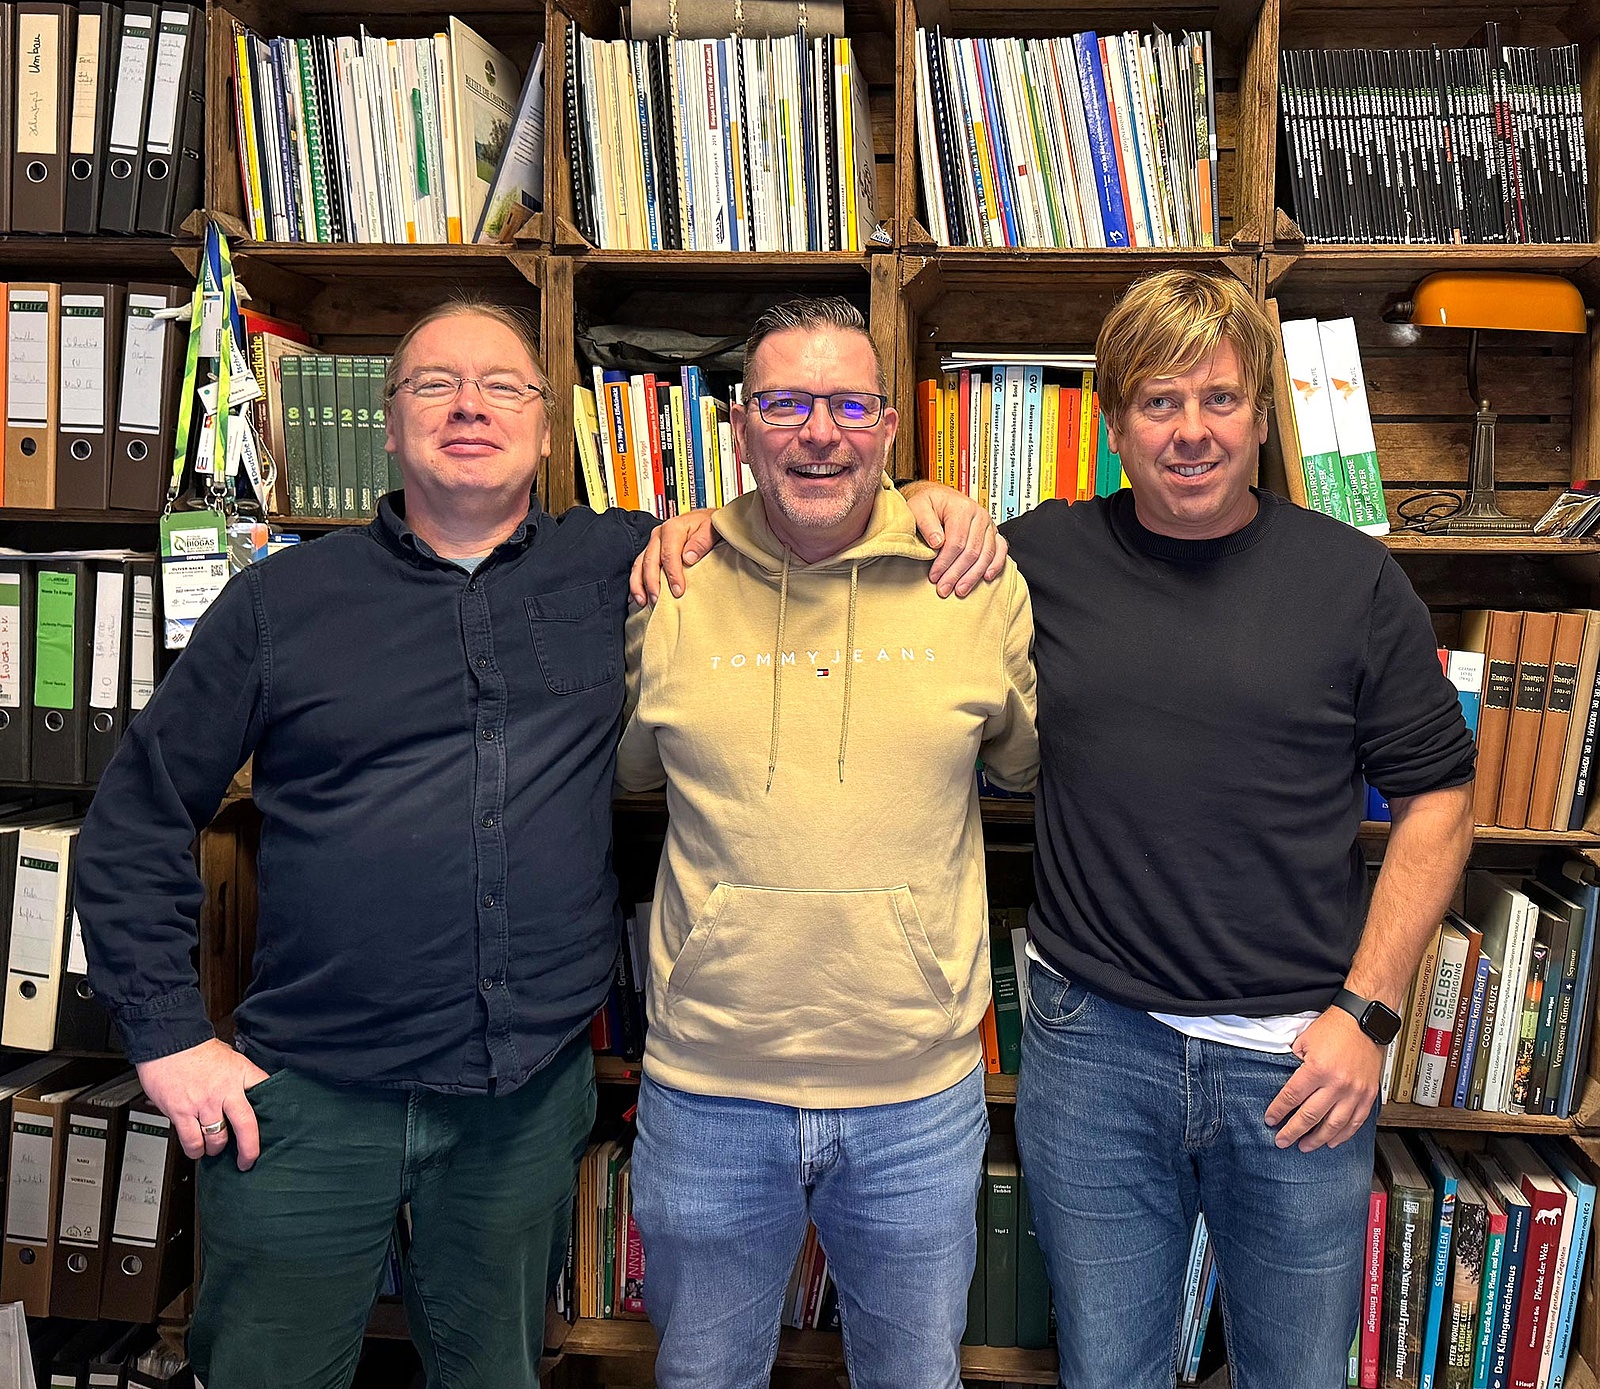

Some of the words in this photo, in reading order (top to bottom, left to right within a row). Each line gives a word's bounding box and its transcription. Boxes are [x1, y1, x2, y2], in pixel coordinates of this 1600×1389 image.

[1495, 103, 1503, 136] PANORAMA
[1502, 103, 1511, 139] PANORAMA
[19, 303, 44, 311] LEITZ
[73, 308, 99, 316] LEITZ
[994, 374, 1002, 393] GVC
[1029, 374, 1037, 394] GVC
[288, 407, 299, 419] 8
[307, 407, 315, 419] 1
[323, 407, 334, 419] 5
[341, 409, 352, 421] 2
[357, 409, 369, 421] 3
[373, 410, 385, 422] 4
[616, 425, 624, 439] Wege
[244, 443, 258, 477] Deutsche
[991, 443, 1000, 498] Schlammbehandlung
[1025, 444, 1034, 499] Schlammbehandlung
[1008, 468, 1016, 497] Abwasser-
[1307, 460, 1321, 513] LTI-PURPOSE
[1318, 469, 1329, 495] PAPER
[1347, 459, 1363, 522] MULTI-PURPOSE
[1359, 469, 1370, 495] PAPER
[1364, 495, 1374, 521] WHITE
[710, 650, 819, 670] TOMMY
[831, 648, 936, 664] JEANS
[1586, 710, 1598, 736] RUDOLPH
[1566, 948, 1577, 977] Seymour
[1415, 953, 1434, 1018] Selbstversorgung
[1433, 958, 1454, 1019] SELBST
[1446, 962, 1462, 1020] VERSORGUNG
[1470, 974, 1486, 1019] knoff-hoff
[1559, 996, 1570, 1024] Künste
[1434, 1030, 1443, 1055] SCORPIO
[1454, 1018, 1463, 1048] ERZÄHL
[1481, 1016, 1493, 1048] COOLE
[1450, 1048, 1458, 1068] MAL!
[1553, 1026, 1567, 1068] Vergessene
[1422, 1062, 1434, 1097] WOLFGANG
[1431, 1078, 1439, 1099] FUNKE
[1404, 1223, 1416, 1241] Der
[1579, 1215, 1588, 1229] nach
[628, 1239, 641, 1277] WANN
[1370, 1227, 1382, 1282] Biotechnologie
[1401, 1241, 1414, 1269] große
[1434, 1232, 1449, 1287] SEYCHELLEN
[1539, 1242, 1549, 1261] Welt
[1191, 1268, 1200, 1284] Wald
[1537, 1261, 1546, 1275] der
[1370, 1283, 1380, 1295] für
[1399, 1269, 1413, 1299] Natur-
[1533, 1275, 1545, 1301] Pferde
[1399, 1299, 1410, 1317] und
[1461, 1300, 1469, 1322] LEBEN
[1482, 1316, 1491, 1334] große
[1488, 1269, 1496, 1289] Pferde
[1496, 1265, 1517, 1353] Kleingewächshaus
[1551, 1287, 1561, 1310] gestalten
[1367, 1296, 1379, 1333] Einsteiger
[1451, 1302, 1461, 1343] WOHLLEBEN
[1549, 1310, 1557, 1321] und
[1458, 1323, 1467, 1352] GEHEIME
[1546, 1321, 1555, 1339] bauen
[1395, 1317, 1409, 1381] Freizeitführer
[1448, 1344, 1457, 1366] PETER
[1456, 1353, 1464, 1367] DAS
[1463, 1353, 1471, 1367] DER
[1543, 1339, 1552, 1357] Selbst
[1494, 1355, 1505, 1374] Das
